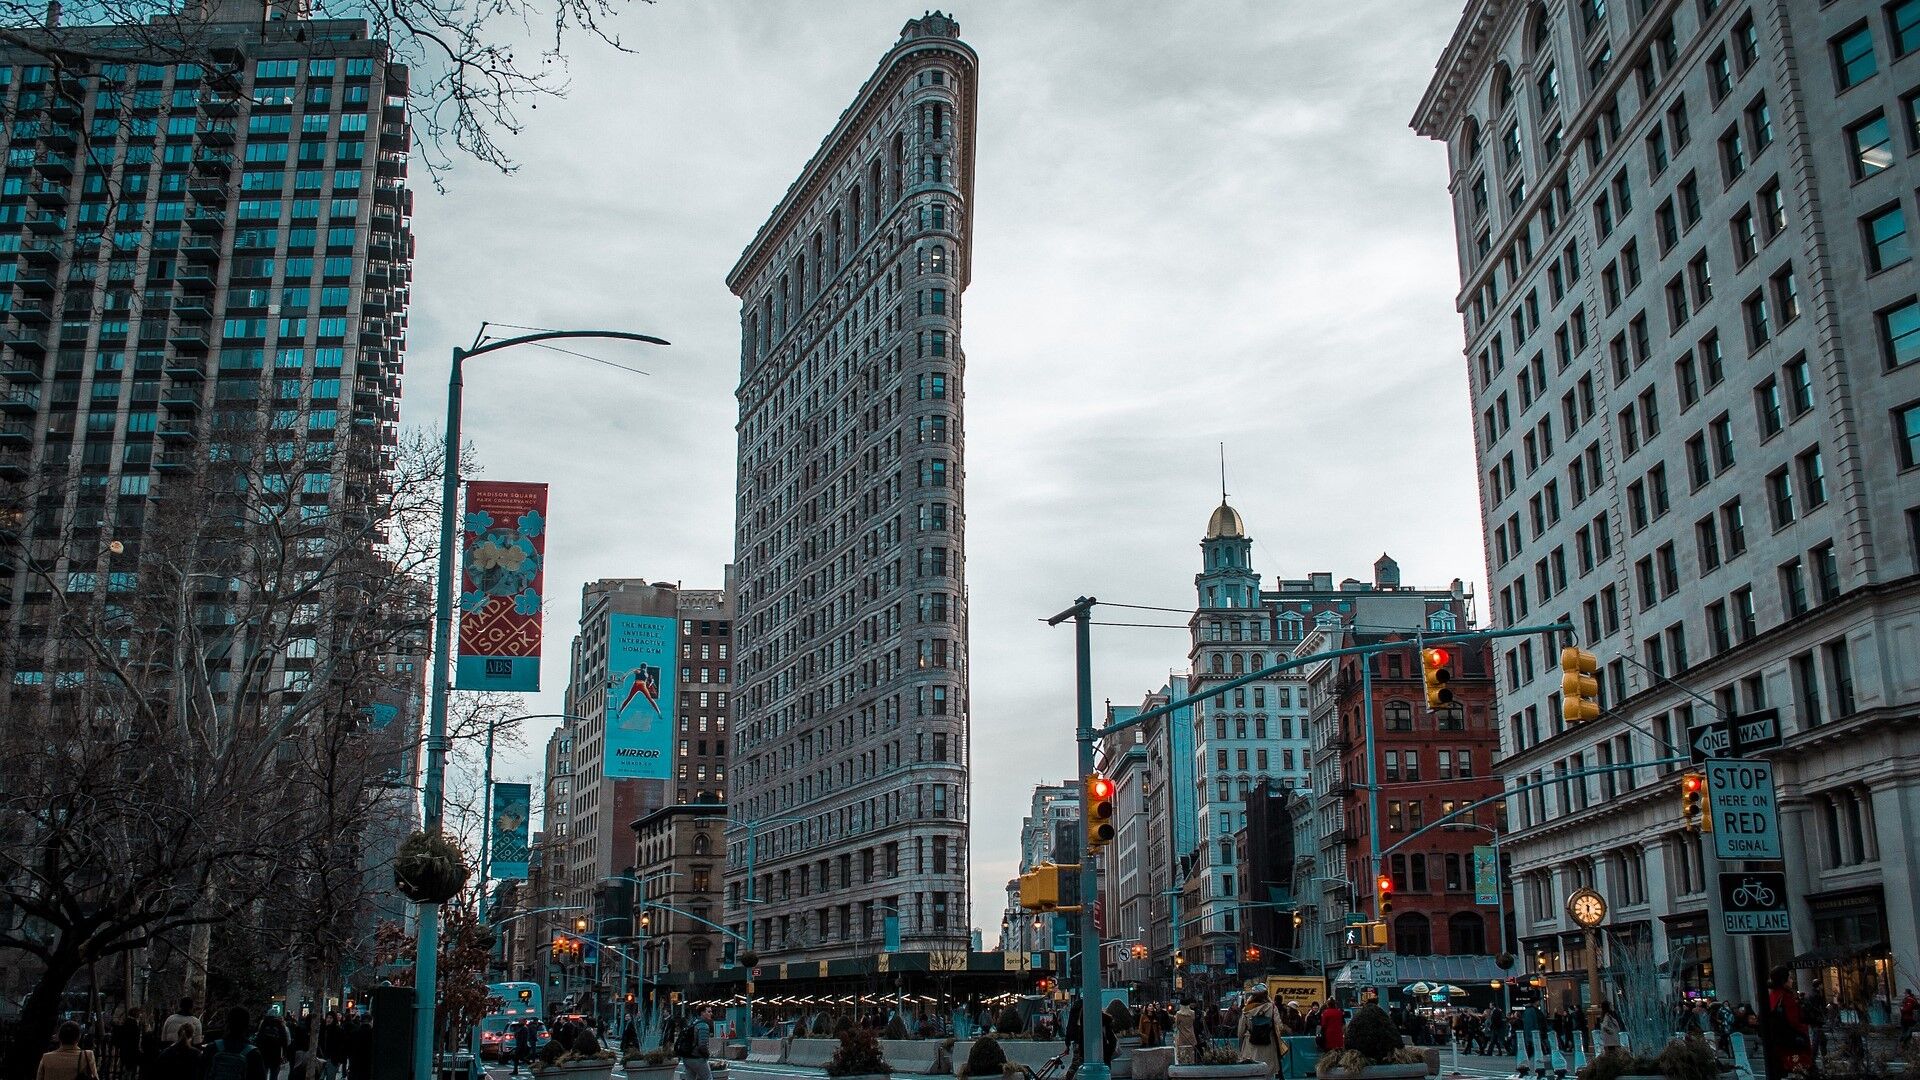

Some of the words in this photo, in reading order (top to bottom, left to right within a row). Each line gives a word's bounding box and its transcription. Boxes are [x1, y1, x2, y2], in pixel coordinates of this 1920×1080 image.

[637, 623, 665, 631] NEARLY
[619, 637, 666, 646] INTERACTIVE
[486, 660, 512, 673] ABS
[1702, 731, 1728, 750] ONE
[1739, 721, 1767, 742] WAY
[616, 748, 660, 758] MIRROR
[1713, 767, 1767, 790] STOP
[1718, 795, 1747, 806] HERE
[1752, 795, 1767, 806] ON
[1724, 812, 1766, 834] RED
[1728, 840, 1769, 851] SIGNAL
[1726, 914, 1753, 929] BIKE
[1756, 913, 1788, 929] LANE
[1276, 987, 1317, 995] PENSKE
